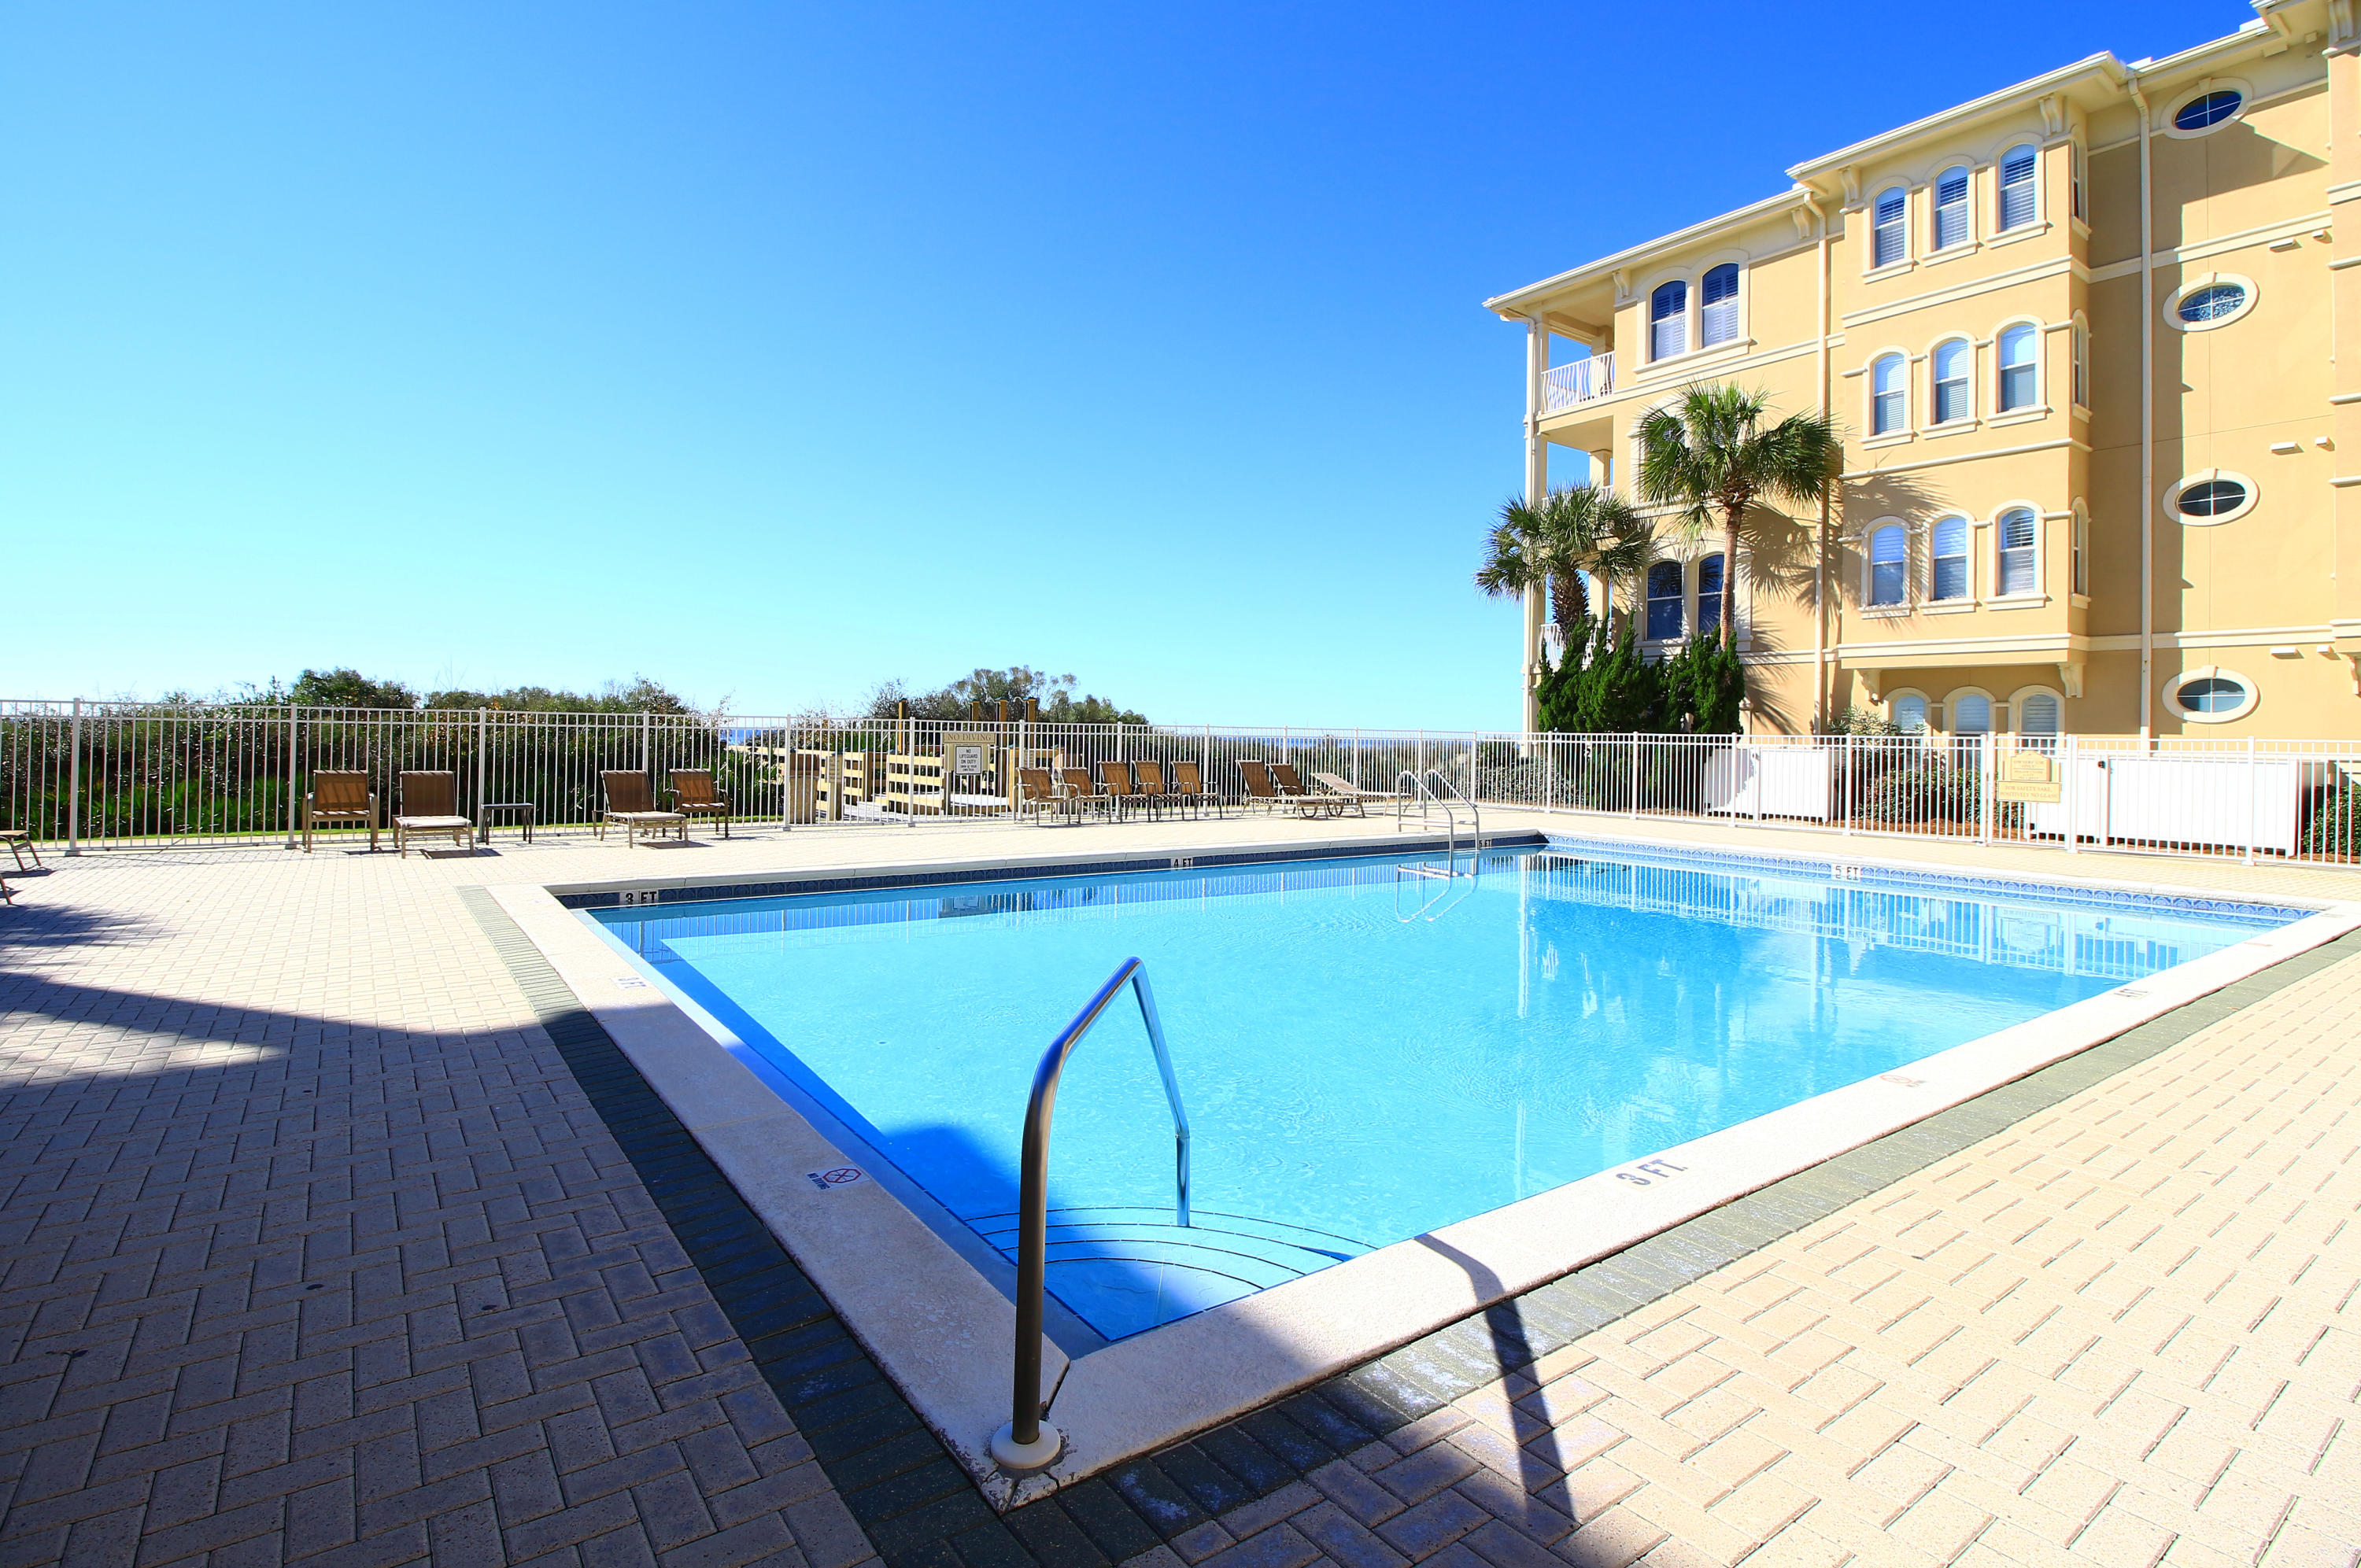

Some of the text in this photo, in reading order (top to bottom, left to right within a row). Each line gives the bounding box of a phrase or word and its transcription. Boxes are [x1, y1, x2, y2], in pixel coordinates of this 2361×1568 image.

[1484, 839, 1491, 847] FT
[1182, 858, 1192, 867] FT
[1847, 866, 1858, 876] FT
[626, 891, 657, 903] 3 FT
[811, 1177, 831, 1190] DIVING
[1616, 1172, 1651, 1186] 3
